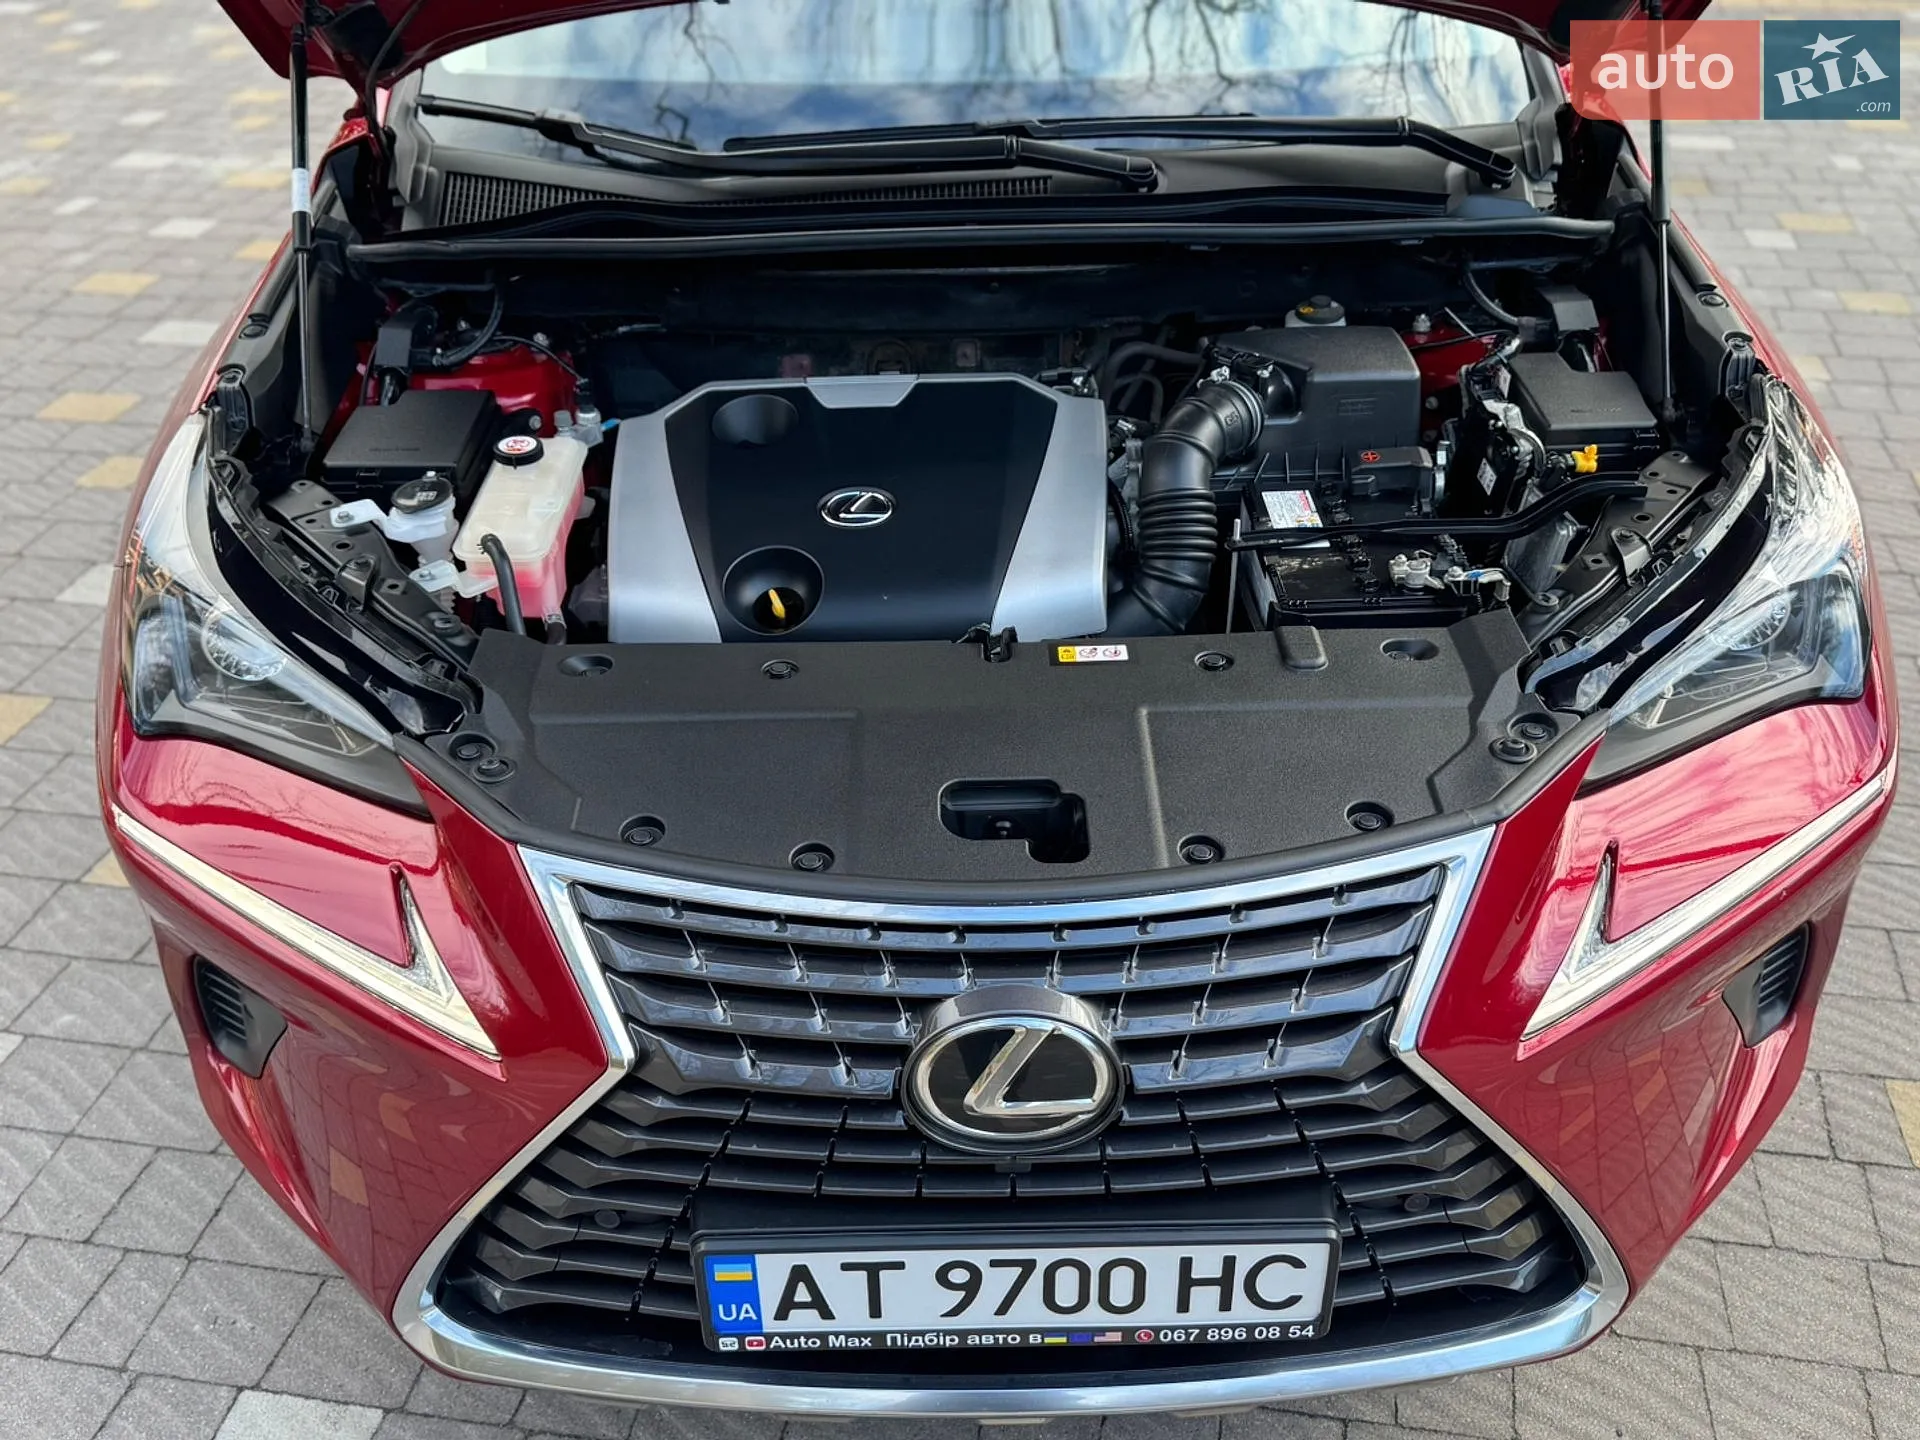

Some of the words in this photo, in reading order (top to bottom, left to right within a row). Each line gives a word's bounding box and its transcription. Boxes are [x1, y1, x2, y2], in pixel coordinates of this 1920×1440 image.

[773, 1261, 906, 1321] AT
[935, 1256, 1147, 1318] 9700
[1176, 1254, 1307, 1314] HC
[718, 1303, 758, 1321] UA
[769, 1335, 821, 1349] Auto
[828, 1334, 872, 1348] Max
[886, 1332, 959, 1349] Підбір
[966, 1333, 1021, 1346] авто
[1029, 1333, 1042, 1344] в
[1159, 1329, 1200, 1342] 067
[1206, 1327, 1247, 1341] 896
[1254, 1326, 1281, 1340] 08
[1288, 1325, 1315, 1338] 54
